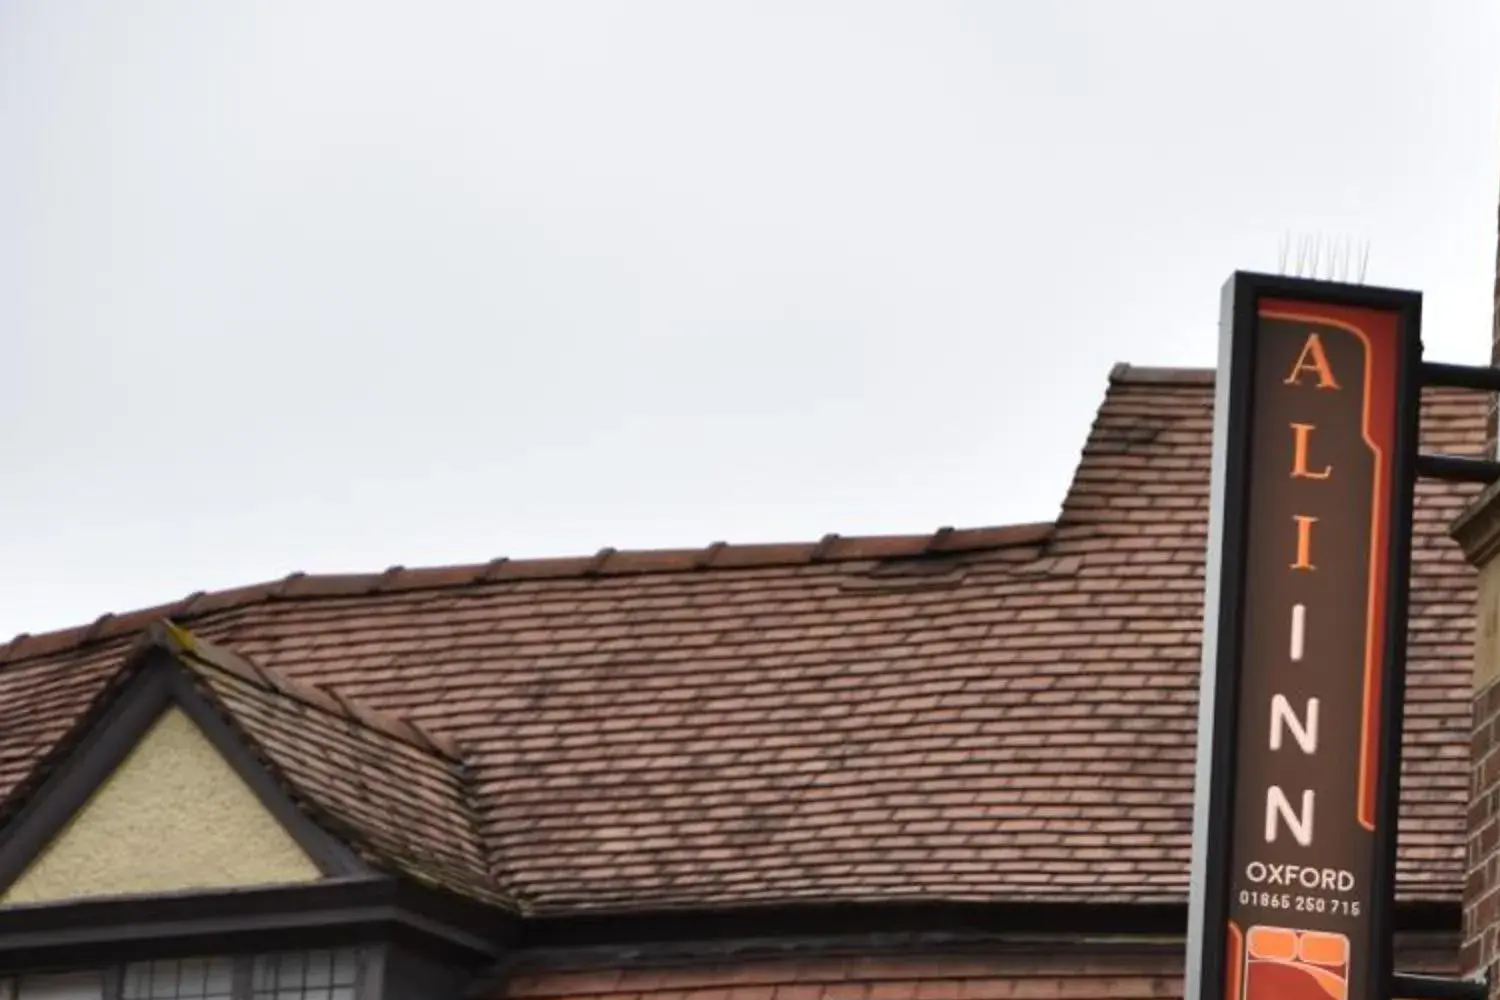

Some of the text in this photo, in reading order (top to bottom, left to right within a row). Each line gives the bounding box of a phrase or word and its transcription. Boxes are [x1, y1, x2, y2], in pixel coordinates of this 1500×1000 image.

[1245, 861, 1355, 892] OXFORD
[1239, 889, 1290, 910] 01865
[1295, 895, 1325, 913] 250
